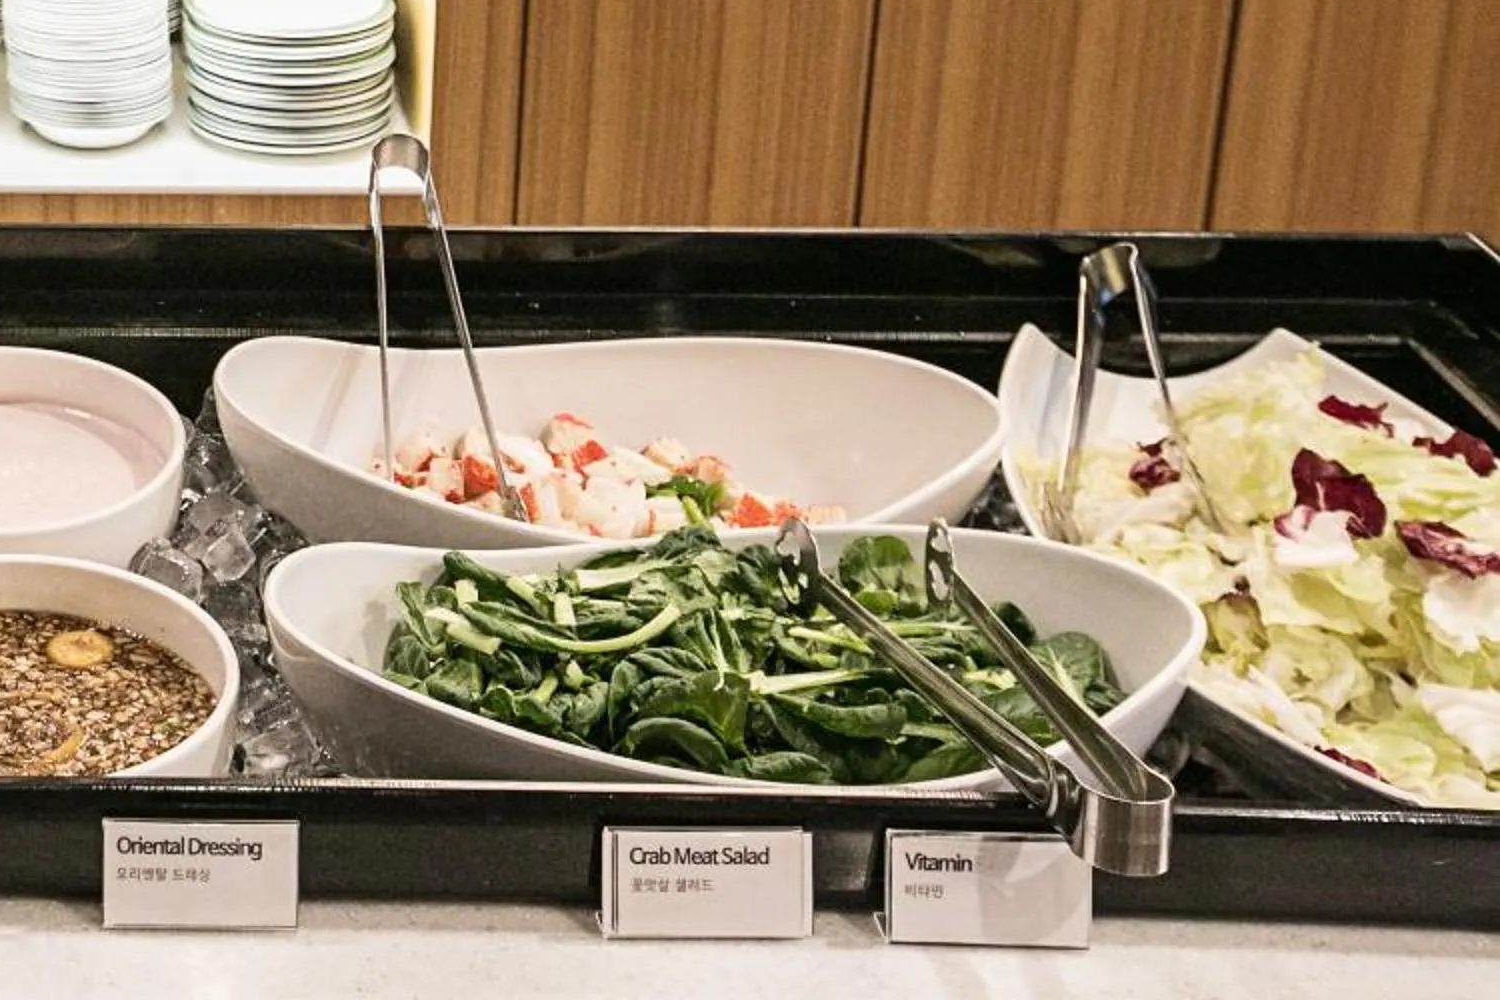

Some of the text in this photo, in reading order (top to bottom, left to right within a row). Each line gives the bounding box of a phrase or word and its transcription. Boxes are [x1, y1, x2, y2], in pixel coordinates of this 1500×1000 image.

[116, 835, 262, 861] Oriental Dressing
[629, 846, 770, 865] Crab Meat Salad
[905, 851, 973, 873] Vitamin
[116, 867, 210, 882] 오리엔탈 드레싱
[904, 882, 944, 900] 비타민
